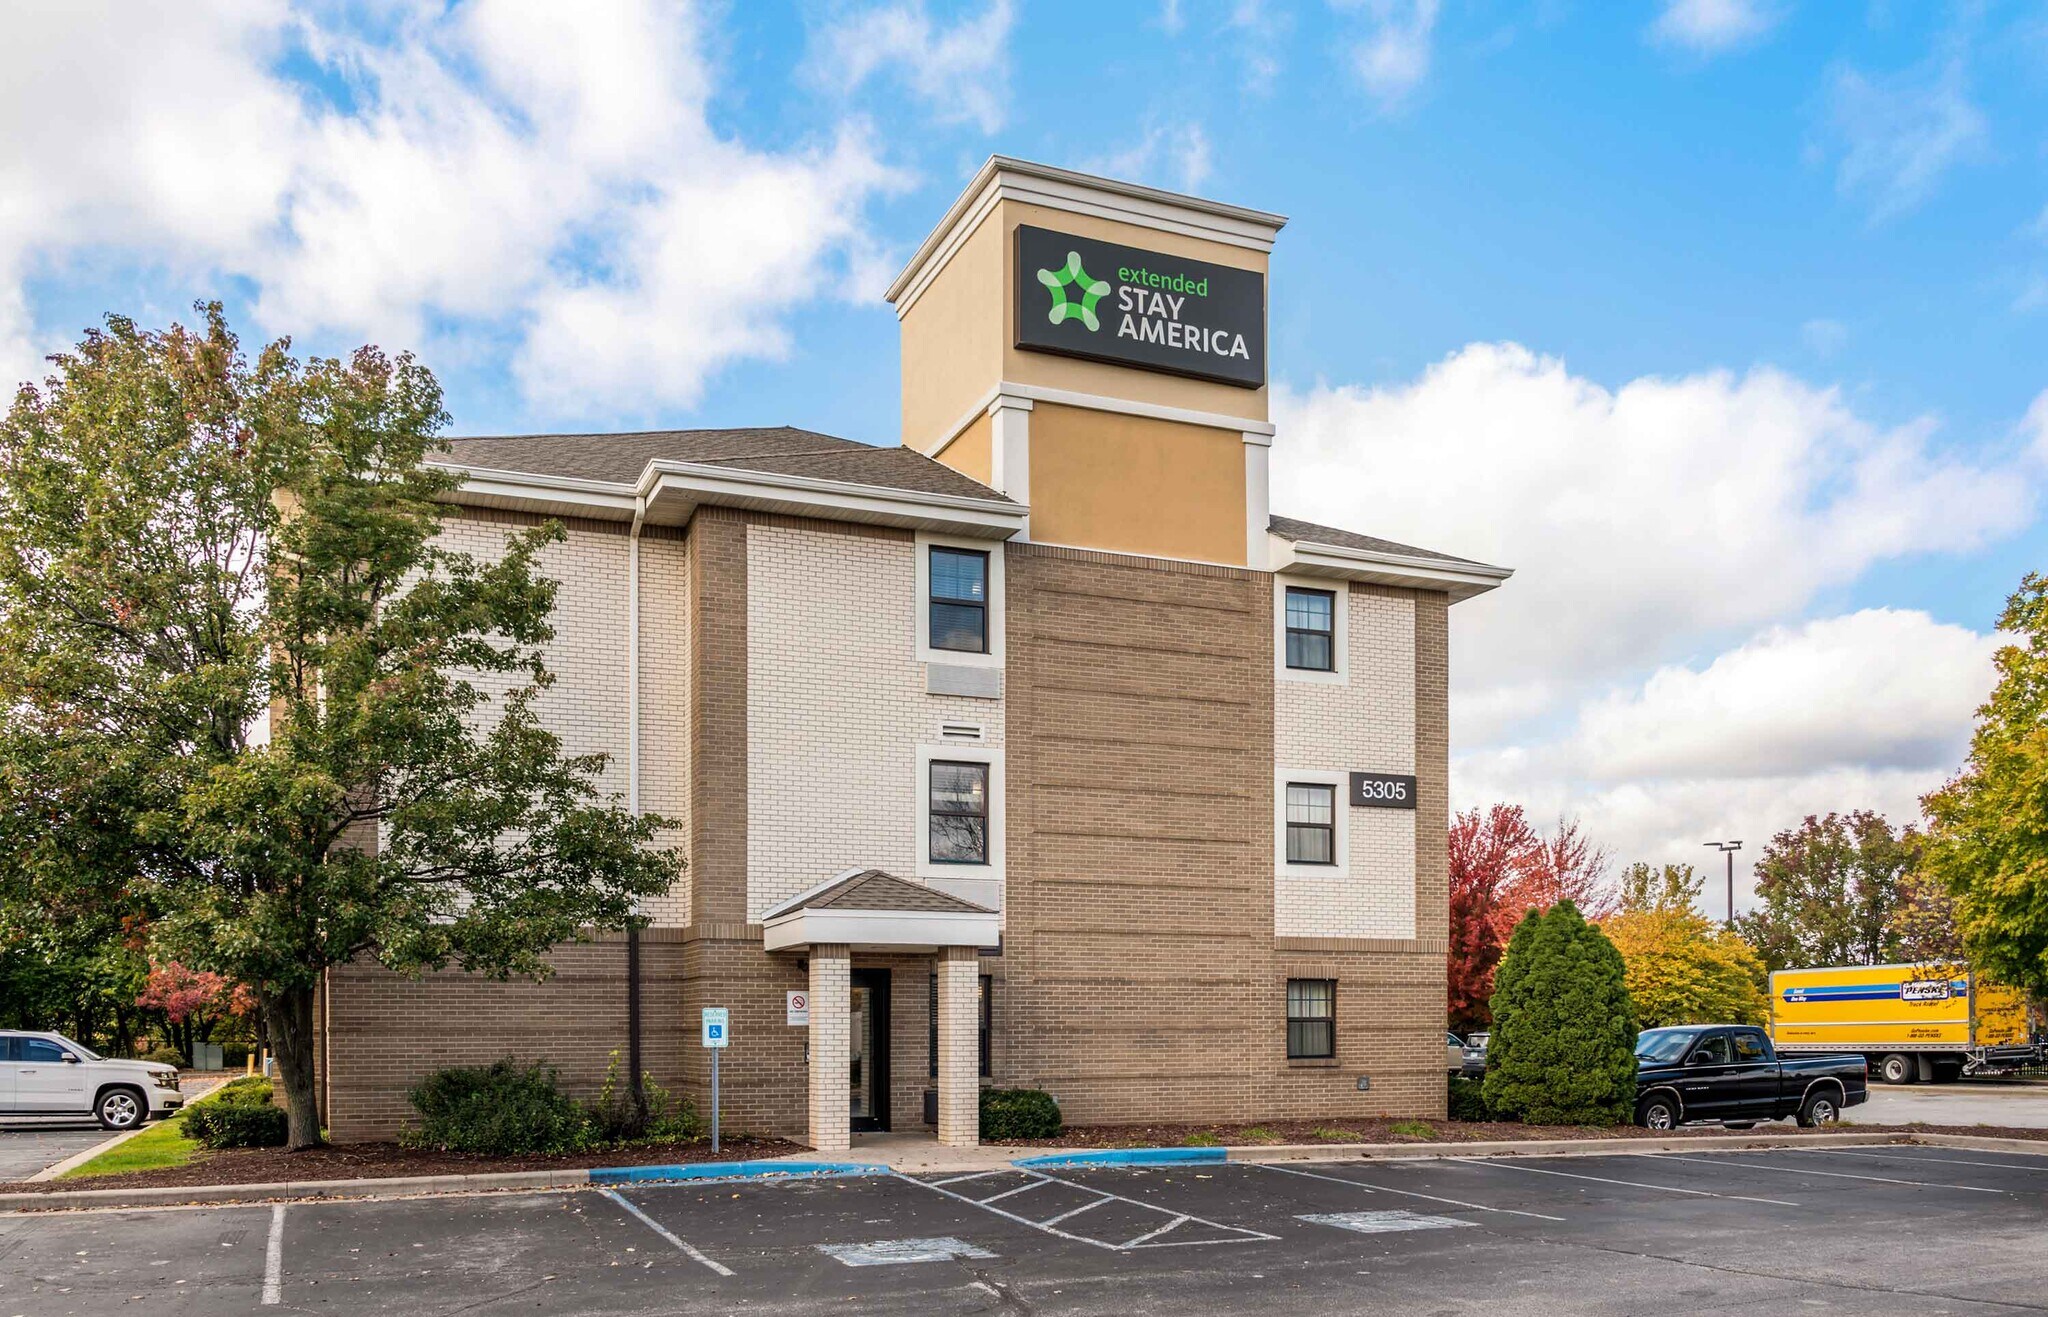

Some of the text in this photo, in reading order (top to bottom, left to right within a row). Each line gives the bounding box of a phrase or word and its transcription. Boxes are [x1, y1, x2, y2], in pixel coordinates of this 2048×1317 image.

[1118, 266, 1208, 297] extended
[1118, 285, 1185, 320] STAY
[1117, 313, 1250, 360] AMERICA
[1362, 780, 1407, 800] 5305
